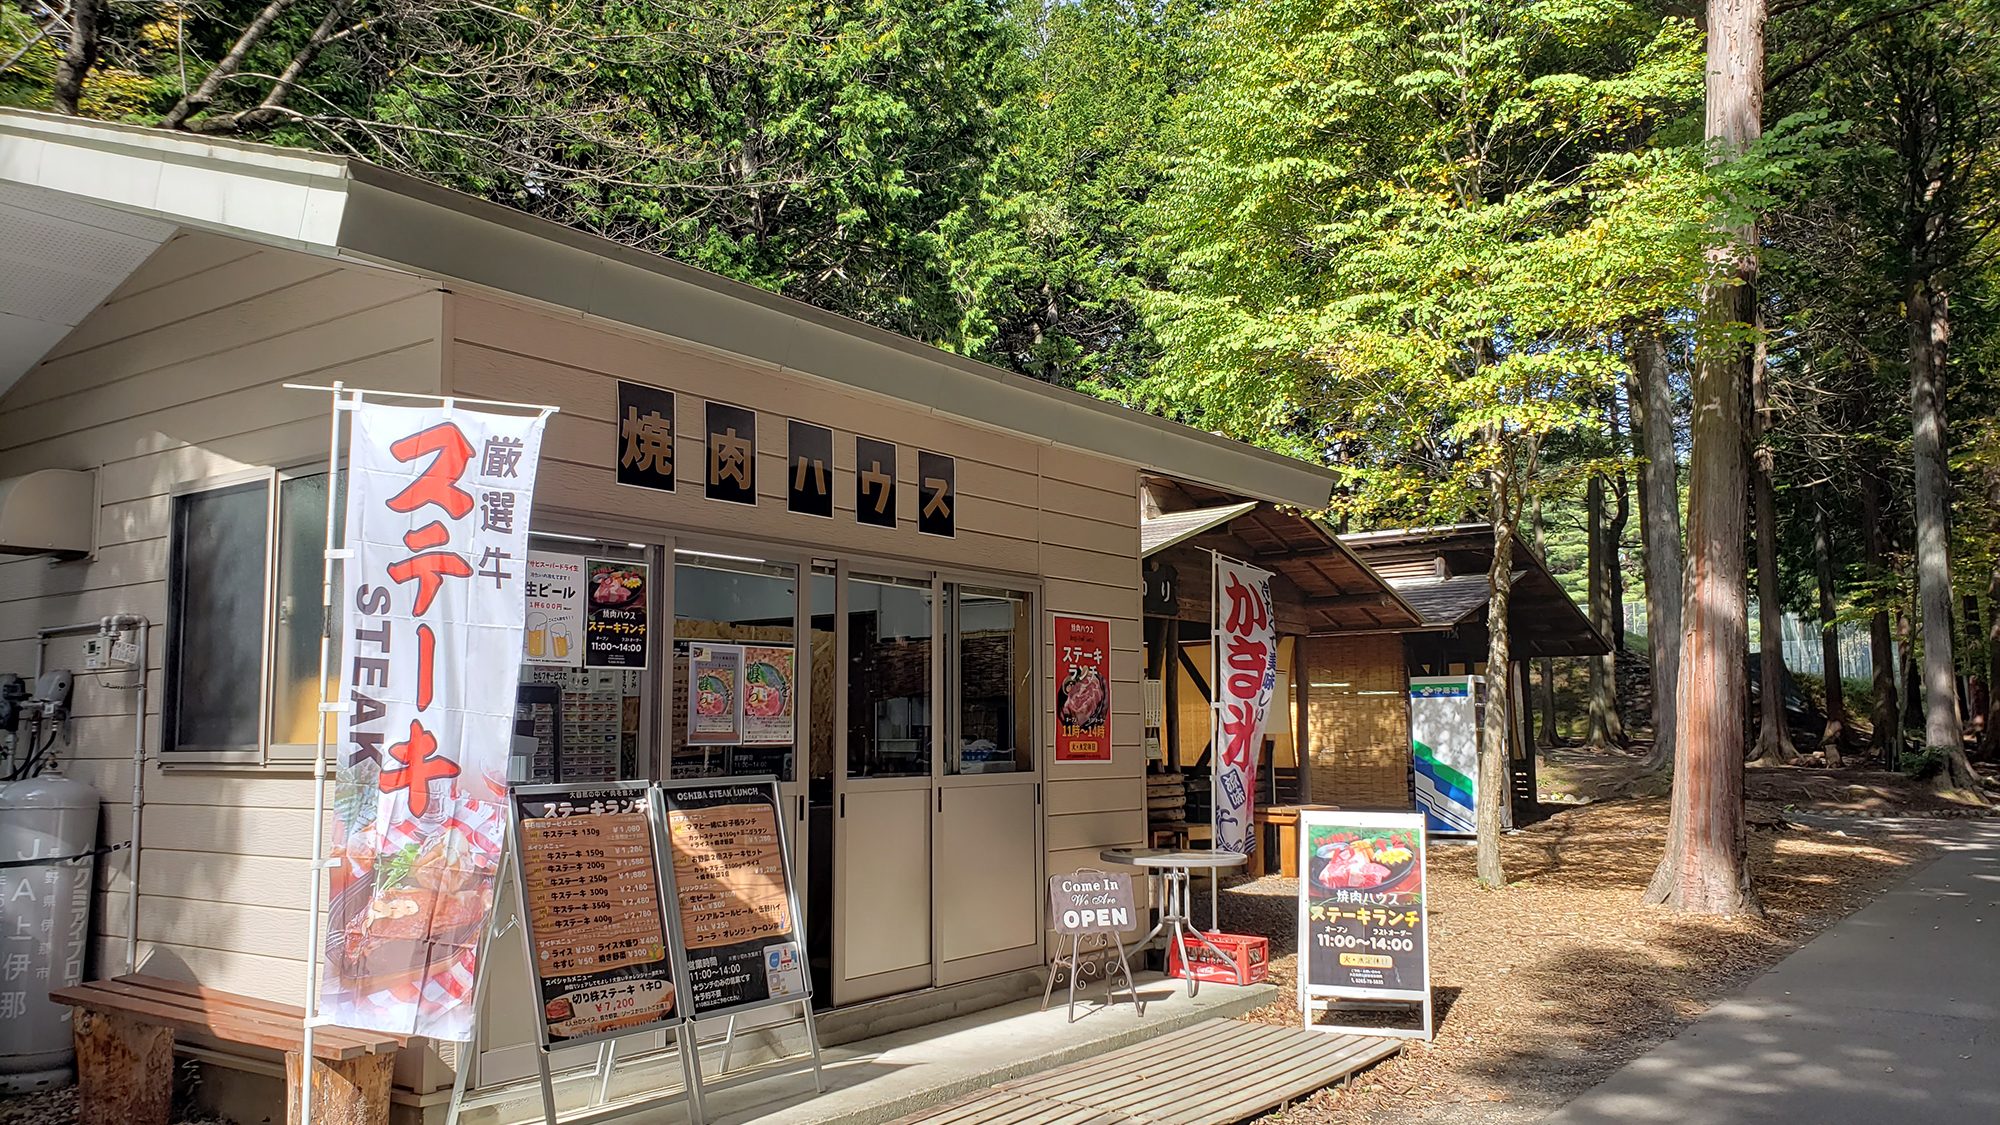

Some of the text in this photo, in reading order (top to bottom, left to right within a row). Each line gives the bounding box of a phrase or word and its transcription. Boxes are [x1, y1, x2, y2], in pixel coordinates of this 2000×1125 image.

[621, 405, 950, 518] 焼肉ハウス
[478, 435, 524, 589] 厳選牛
[527, 560, 579, 572] サヒスーパードライ生
[526, 581, 576, 599] 生ビール
[379, 421, 476, 818] ステーキ
[603, 609, 636, 620] 焼肉ハウス
[588, 621, 646, 634] ステーキランチ
[1062, 646, 1102, 664] ステーキ
[349, 583, 391, 769] STEAK
[1068, 664, 1098, 681] ランチ
[1222, 571, 1267, 773] かき氷
[677, 787, 759, 801] OSHIBA STEAK LUNCH
[543, 797, 650, 819] ステーキランチ
[542, 830, 578, 839] 牛ステーキ
[581, 828, 600, 837] 130g
[547, 850, 582, 860] 牛ステーキ
[585, 849, 604, 857] 150g
[547, 863, 583, 873] 牛ステーキ
[586, 861, 605, 870] 200g
[550, 876, 586, 886] 牛ステーキ
[588, 874, 608, 883] 250g
[1062, 878, 1119, 893] Come In
[551, 889, 587, 900] 牛ステーキ
[590, 888, 609, 896] 300g
[690, 893, 716, 903] 生ビール
[1071, 892, 1116, 906] We Are
[1336, 889, 1400, 905] 焼肉ハウス
[553, 903, 589, 914] 牛ステーキ
[592, 901, 611, 910] 350g
[692, 904, 705, 912] ALL
[554, 916, 590, 928] 牛ステーキ
[593, 915, 613, 924] 400g
[1063, 907, 1128, 929] OPEN
[1310, 906, 1420, 928] ステーキランチ
[1325, 925, 1413, 937] オープン ラストオーダー
[552, 947, 573, 958] ライス
[598, 939, 639, 951] ライス大盛り
[1317, 933, 1414, 952] 11:00～14:00
[553, 959, 575, 970] 牛すじ
[598, 951, 627, 963] 焼き野菜
[687, 956, 718, 971] 営業時間
[572, 980, 663, 1005] 切り株ステーキ 1キロ
